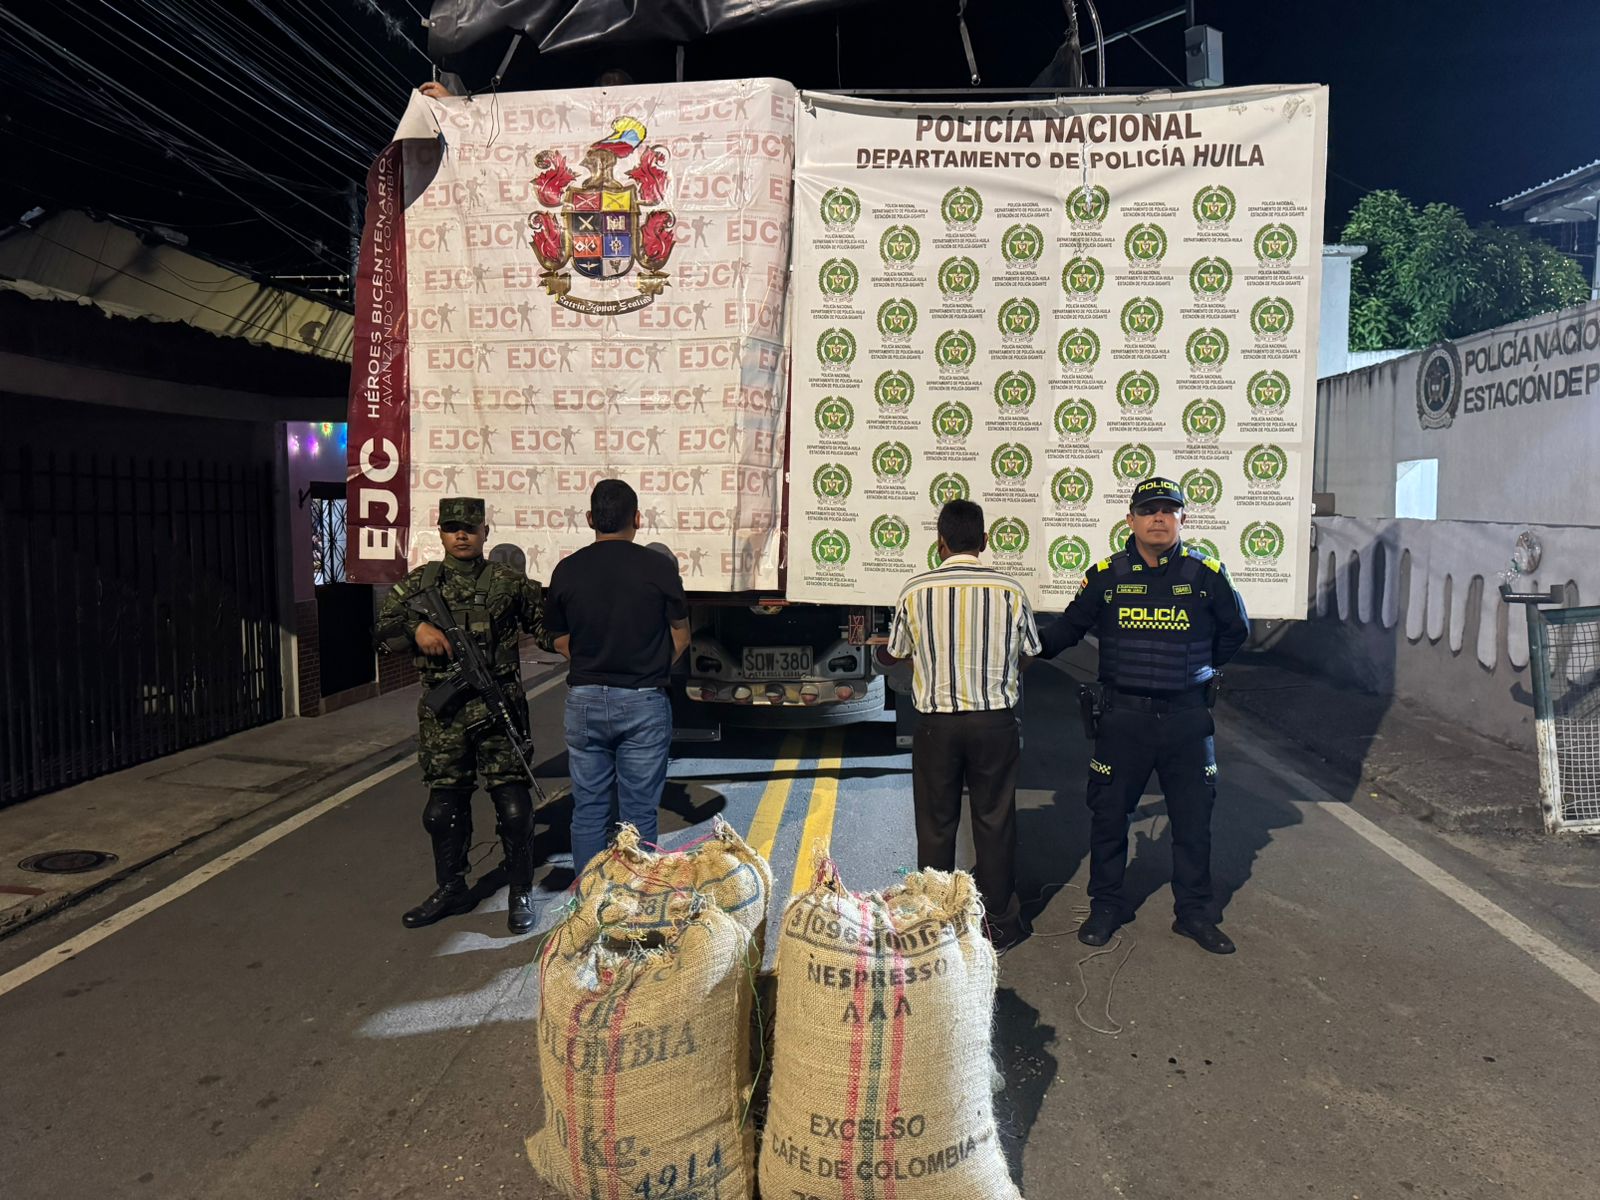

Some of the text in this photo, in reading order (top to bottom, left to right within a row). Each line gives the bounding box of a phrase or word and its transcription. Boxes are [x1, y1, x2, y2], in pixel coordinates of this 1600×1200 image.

[503, 108, 556, 131] EJC
[678, 99, 732, 121] EJC
[916, 109, 1202, 144] POLICÍA NACIONAL
[727, 132, 781, 156] EJC
[856, 143, 1264, 170] DEPARTAMENTO DE POLICÍA HUILA
[423, 181, 467, 208] EJC
[676, 175, 731, 200] EJC
[465, 223, 513, 247] EJC
[727, 220, 778, 243] EJC
[382, 157, 395, 406] AVANZANDO POR COLOMBIA
[424, 269, 473, 290] EJC
[679, 264, 730, 287] EJC
[364, 157, 387, 418] HÉROES BICENTENARIO
[469, 306, 517, 328] EJC
[639, 305, 691, 327] EJC
[725, 302, 771, 327] EJC
[427, 348, 474, 369] EJC
[507, 348, 556, 368] EJC
[591, 347, 644, 368] EJC
[679, 346, 729, 369] EJC
[1465, 331, 1532, 376] POLICÍA
[553, 390, 605, 410] EJC
[723, 386, 764, 411] EJC
[1464, 364, 1552, 414] ESTACIÓN
[1554, 365, 1584, 400] DE
[473, 390, 521, 411] EJC
[640, 390, 691, 411] EJC
[429, 430, 480, 450] EJC
[511, 430, 562, 450] EJC
[594, 430, 645, 450] EJC
[679, 429, 726, 450] EJC
[476, 470, 525, 490] EJC
[640, 471, 689, 491] EJC
[721, 471, 761, 492] EJC
[360, 438, 399, 561] EJC
[514, 510, 565, 529] EJC
[677, 511, 726, 531] EJC
[1119, 605, 1190, 622] POLICÍA
[808, 958, 947, 989] NESPRESSO
[810, 1113, 926, 1141] EXCELSO
[772, 1134, 977, 1180] CAFÉ DE COLOMBIA
